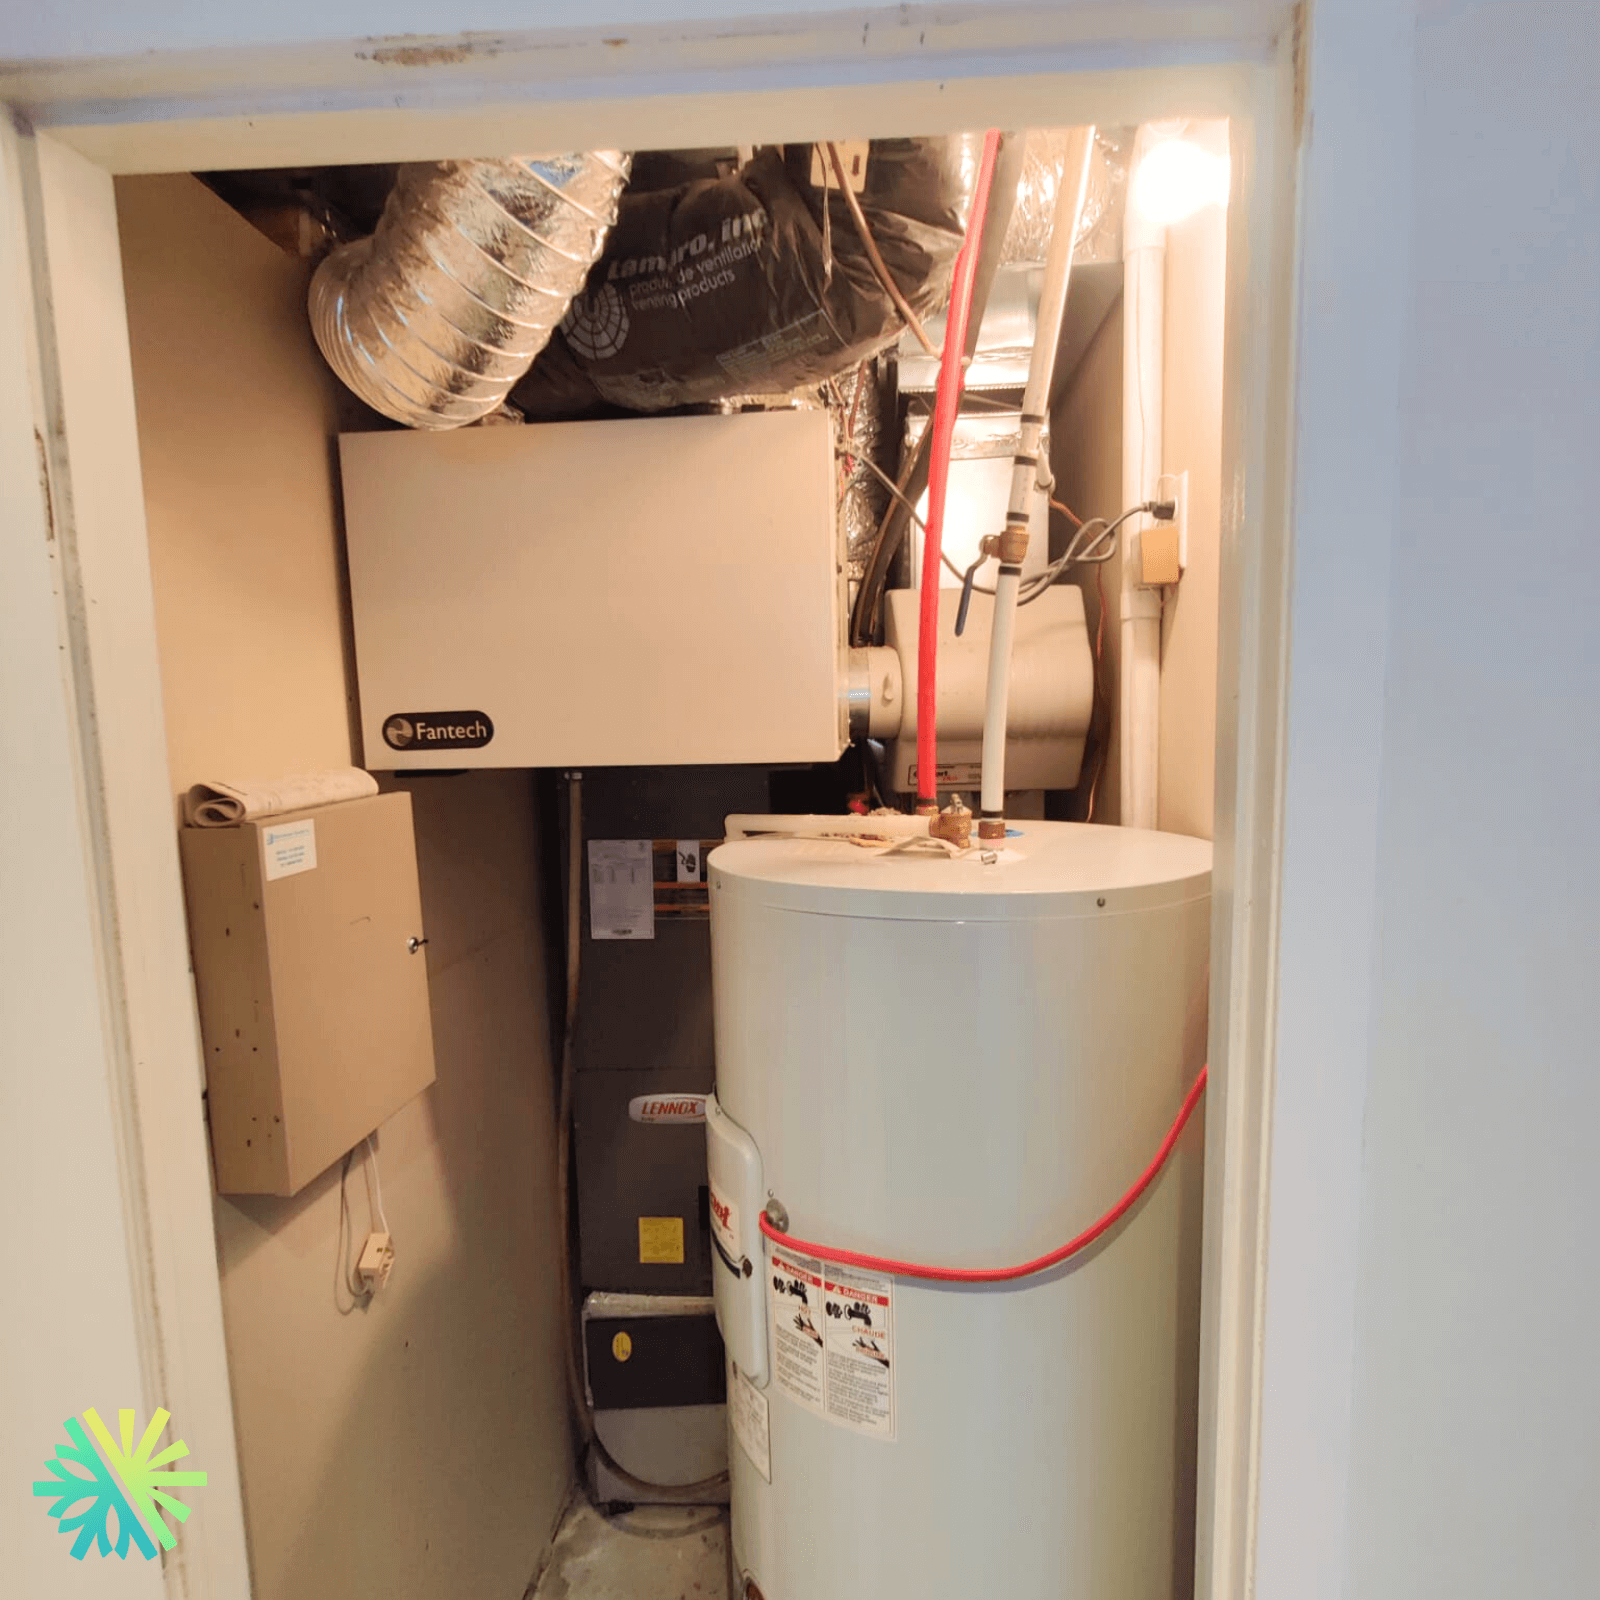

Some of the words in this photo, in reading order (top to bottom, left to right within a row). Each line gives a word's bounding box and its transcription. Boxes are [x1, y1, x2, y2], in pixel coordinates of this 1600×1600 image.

[677, 268, 736, 307] products
[416, 720, 487, 740] Fantech
[642, 1101, 698, 1115] LENNOX
[842, 1287, 878, 1304] DANGER
[852, 1325, 885, 1339] CHAUDE
